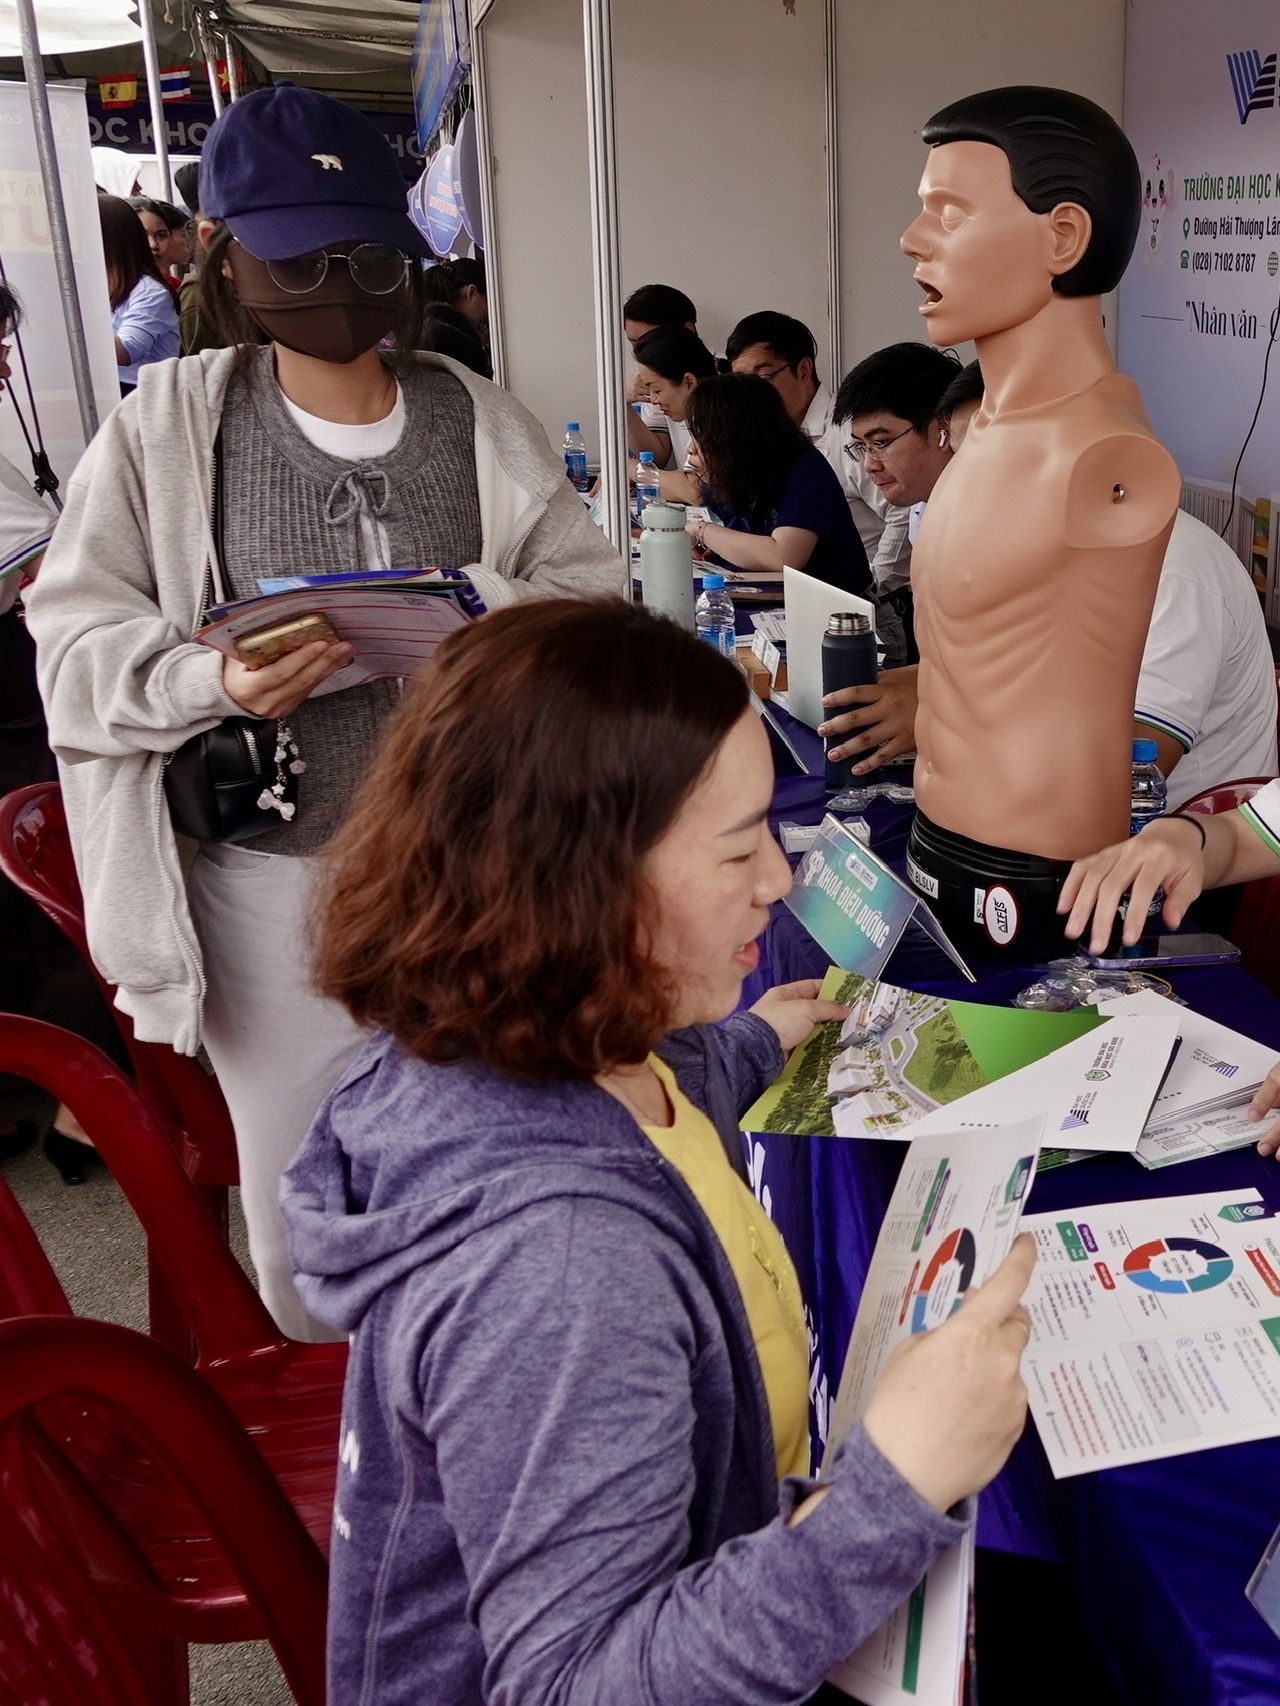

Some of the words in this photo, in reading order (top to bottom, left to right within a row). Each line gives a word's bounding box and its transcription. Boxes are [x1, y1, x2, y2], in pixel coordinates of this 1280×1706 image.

[1184, 171, 1223, 201] TRƯỜNG
[1227, 175, 1245, 204] ĐẠI
[1250, 174, 1271, 203] HỌC
[1194, 217, 1217, 239] Đường
[1220, 215, 1232, 236] Hải
[1235, 216, 1264, 240] Thượng
[1192, 252, 1212, 274] (028)
[1214, 253, 1234, 271] 7102
[1236, 253, 1256, 272] 8787
[1231, 309, 1258, 340] văn
[817, 862, 840, 900] KHOA
[836, 886, 862, 919] ĐIỀU
[854, 905, 890, 950] DƯỠNG
